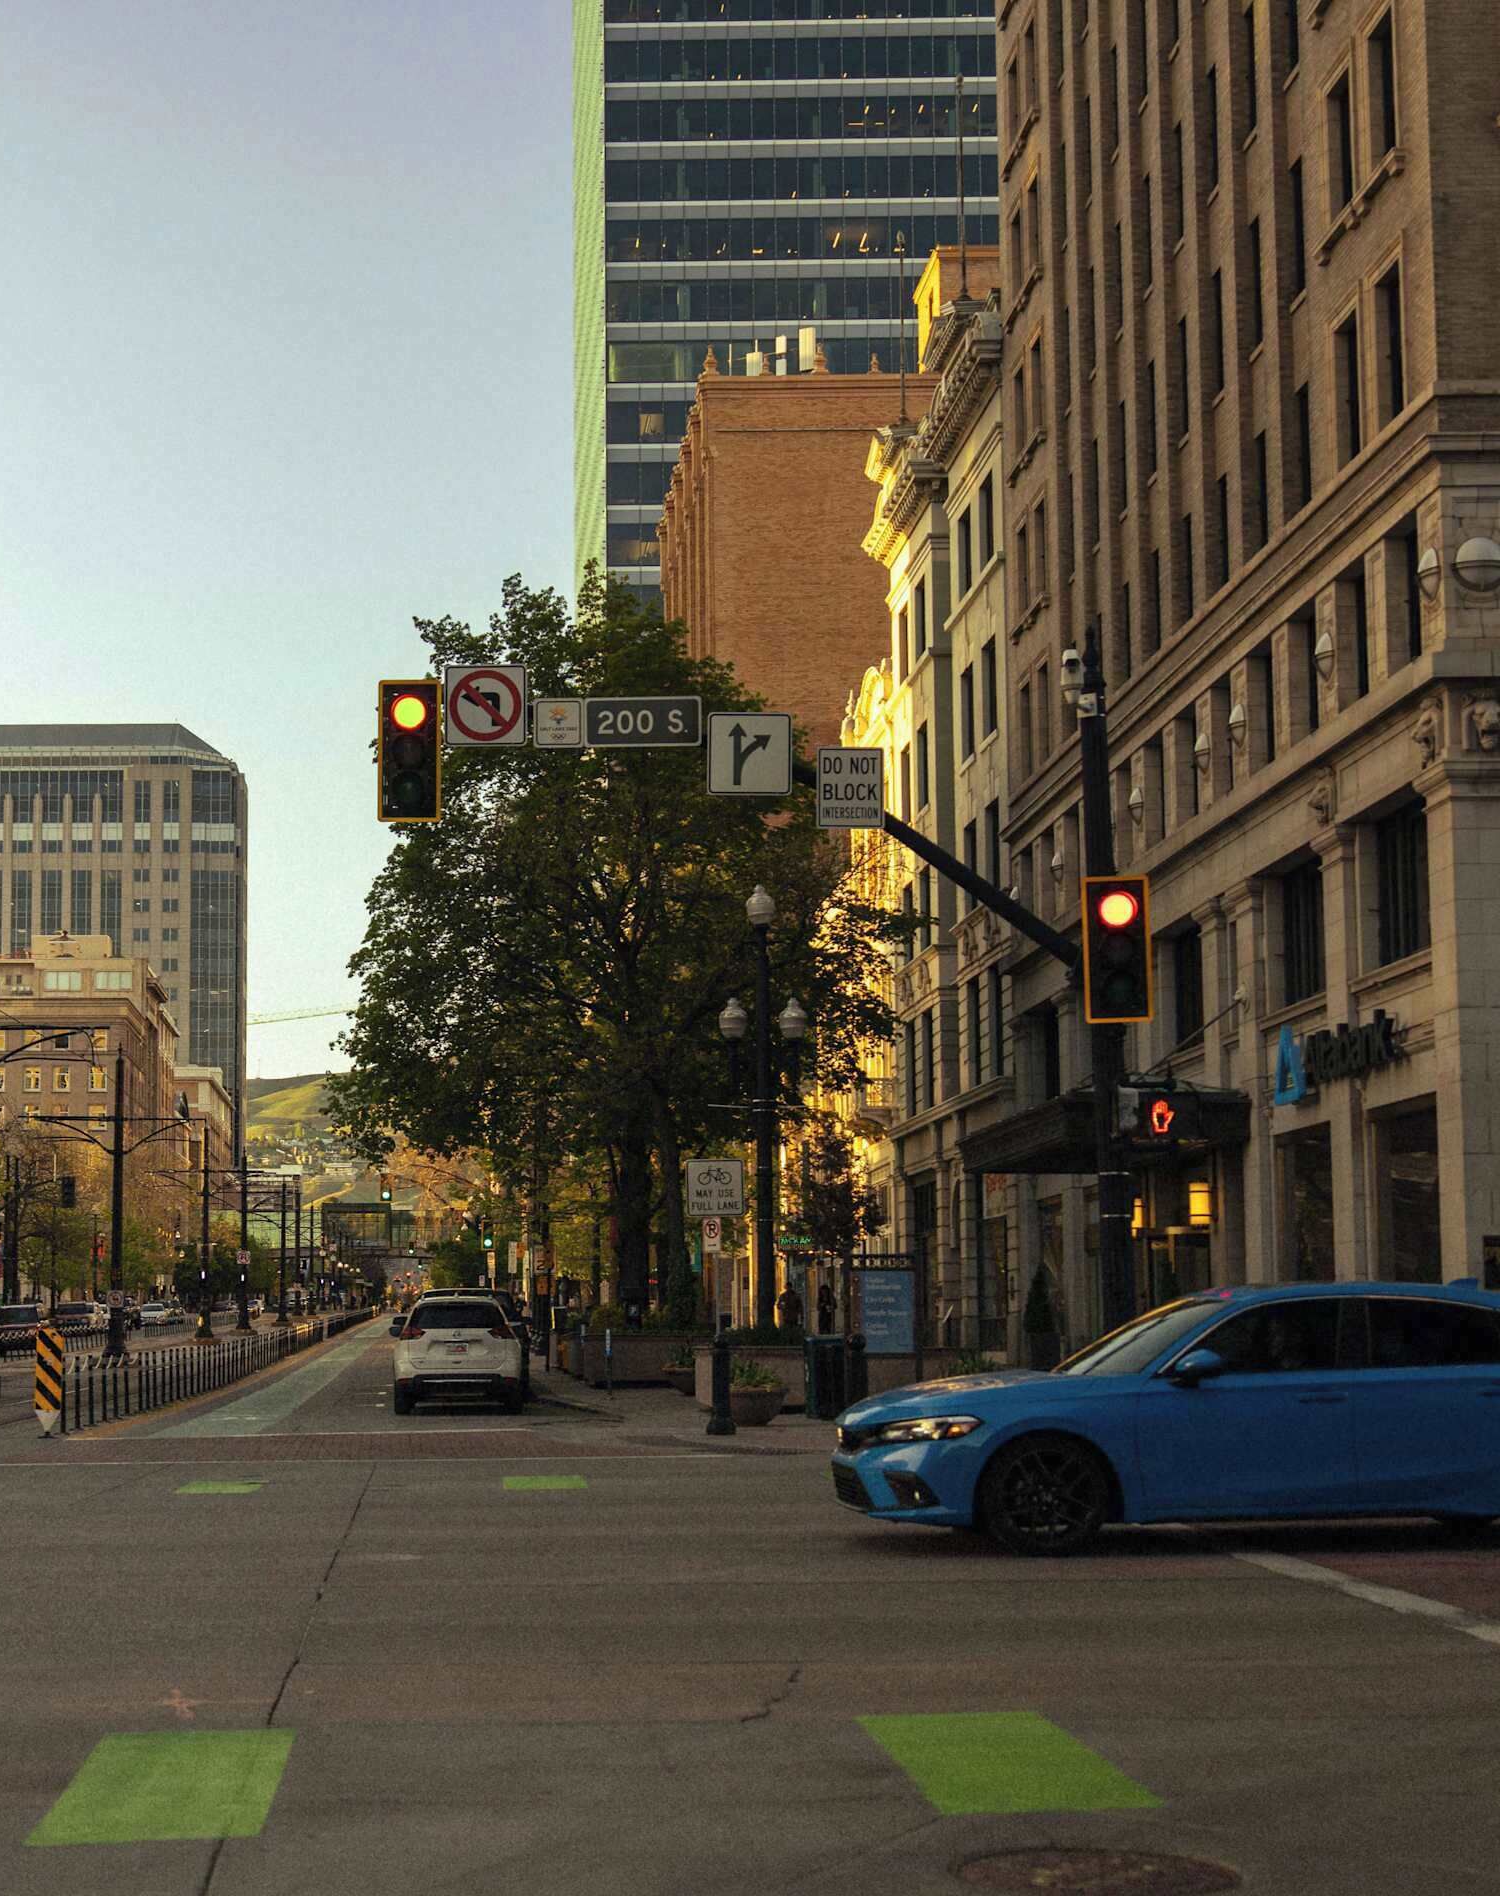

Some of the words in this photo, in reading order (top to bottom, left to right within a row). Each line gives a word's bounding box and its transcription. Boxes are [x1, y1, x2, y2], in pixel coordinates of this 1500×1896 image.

[598, 709, 654, 734] 200
[668, 709, 688, 733] S.
[823, 756, 842, 774] DO
[850, 757, 877, 775] NOT
[823, 783, 877, 801] BLOCK
[822, 806, 879, 819] INTERSECTION
[696, 1189, 712, 1198] MAY
[718, 1189, 734, 1198] USE
[691, 1201, 712, 1210] FULL
[718, 1200, 740, 1210] LANE
